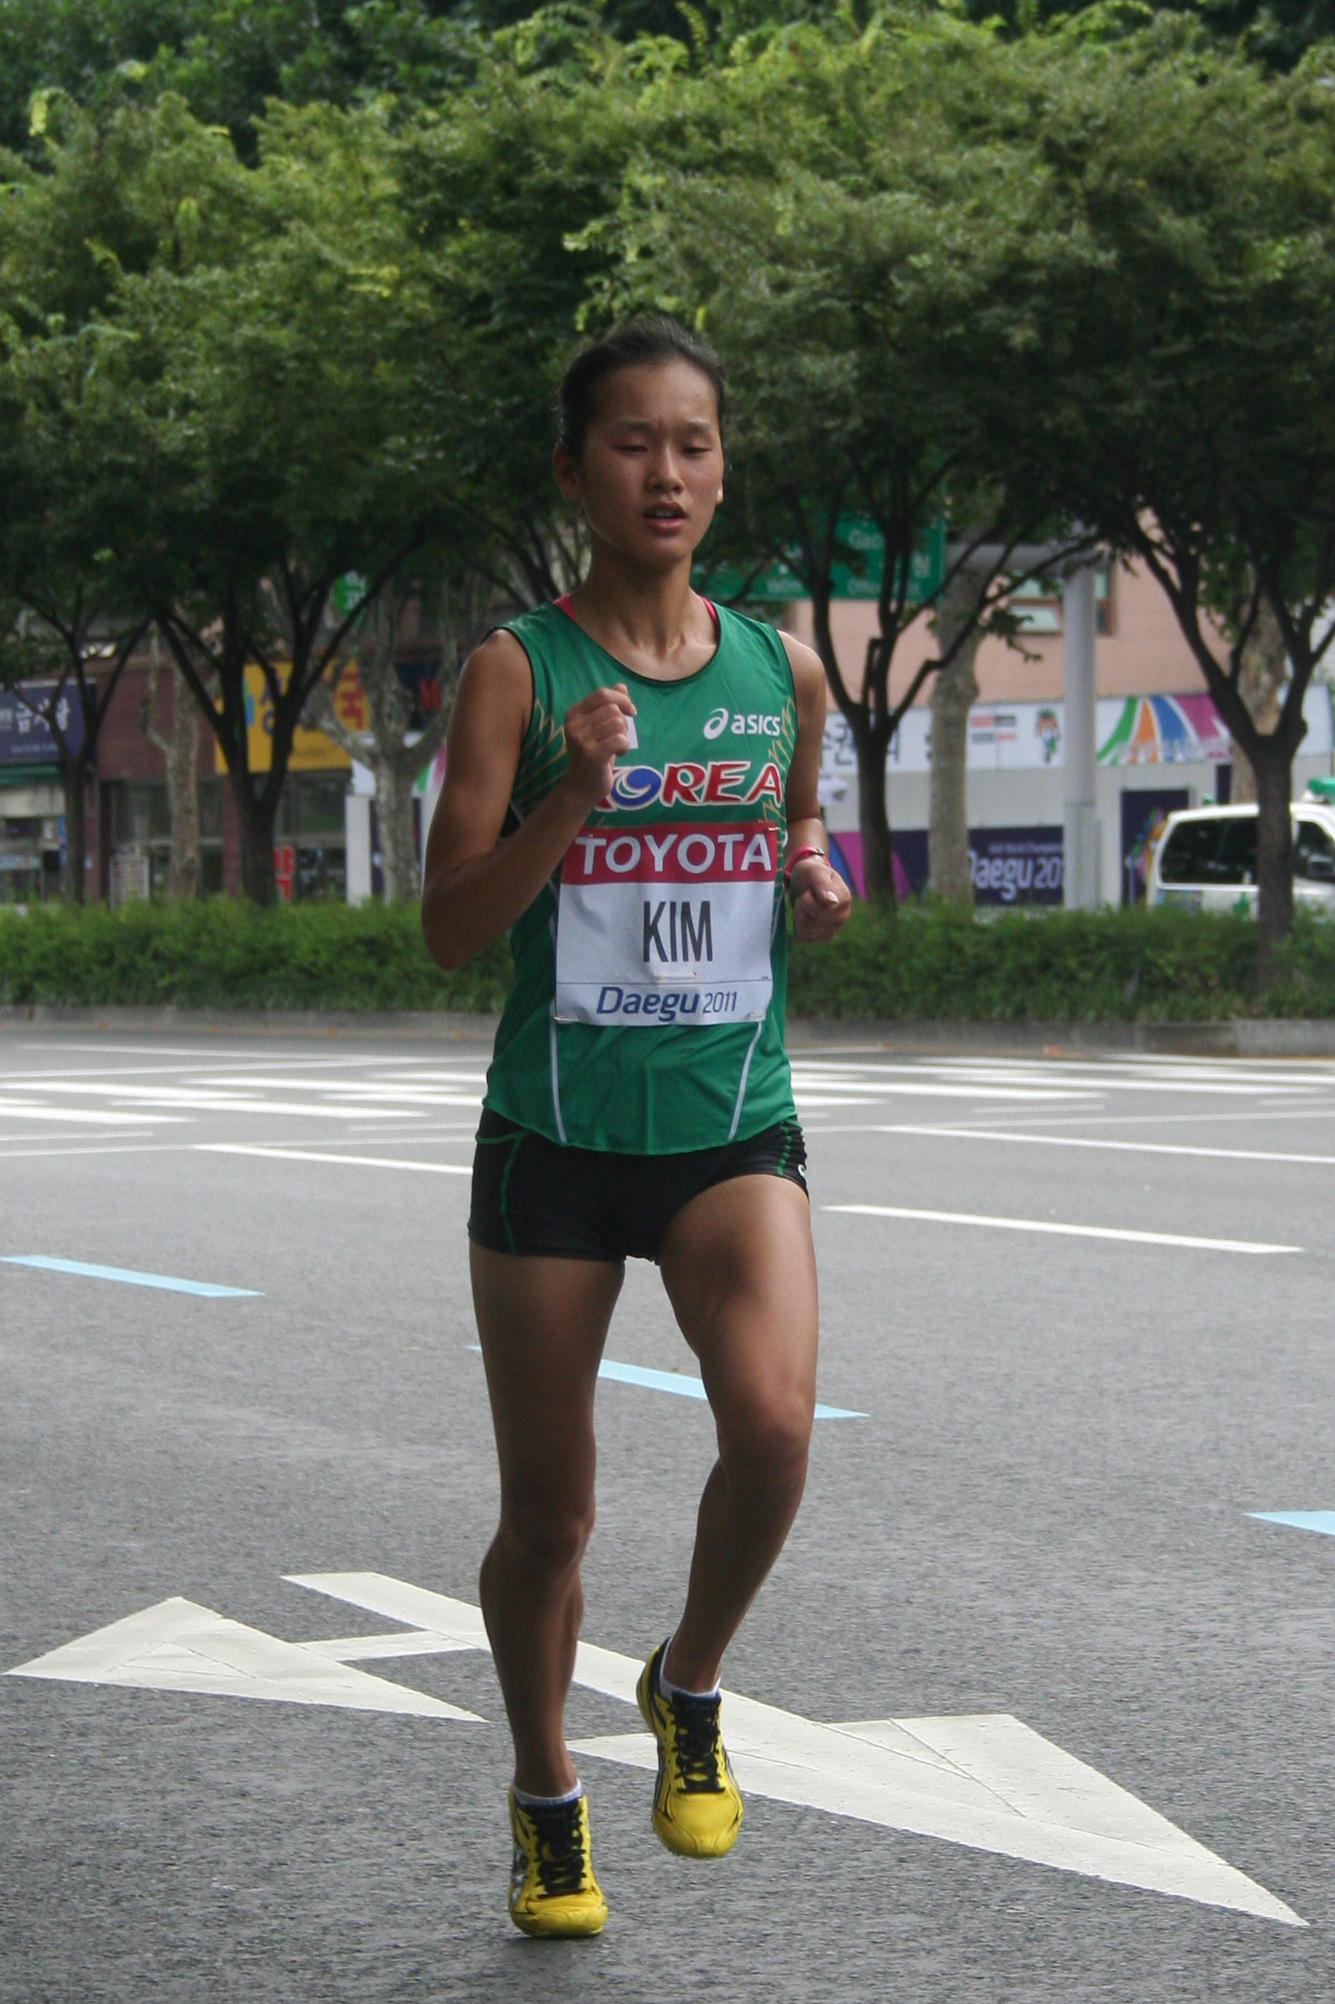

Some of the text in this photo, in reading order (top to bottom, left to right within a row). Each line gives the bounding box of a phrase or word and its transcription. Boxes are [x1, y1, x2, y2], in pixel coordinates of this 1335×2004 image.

[731, 713, 781, 736] asics
[575, 833, 772, 875] TOYOTA
[643, 900, 713, 963] KIM
[596, 986, 738, 1021] Daegu 2011
